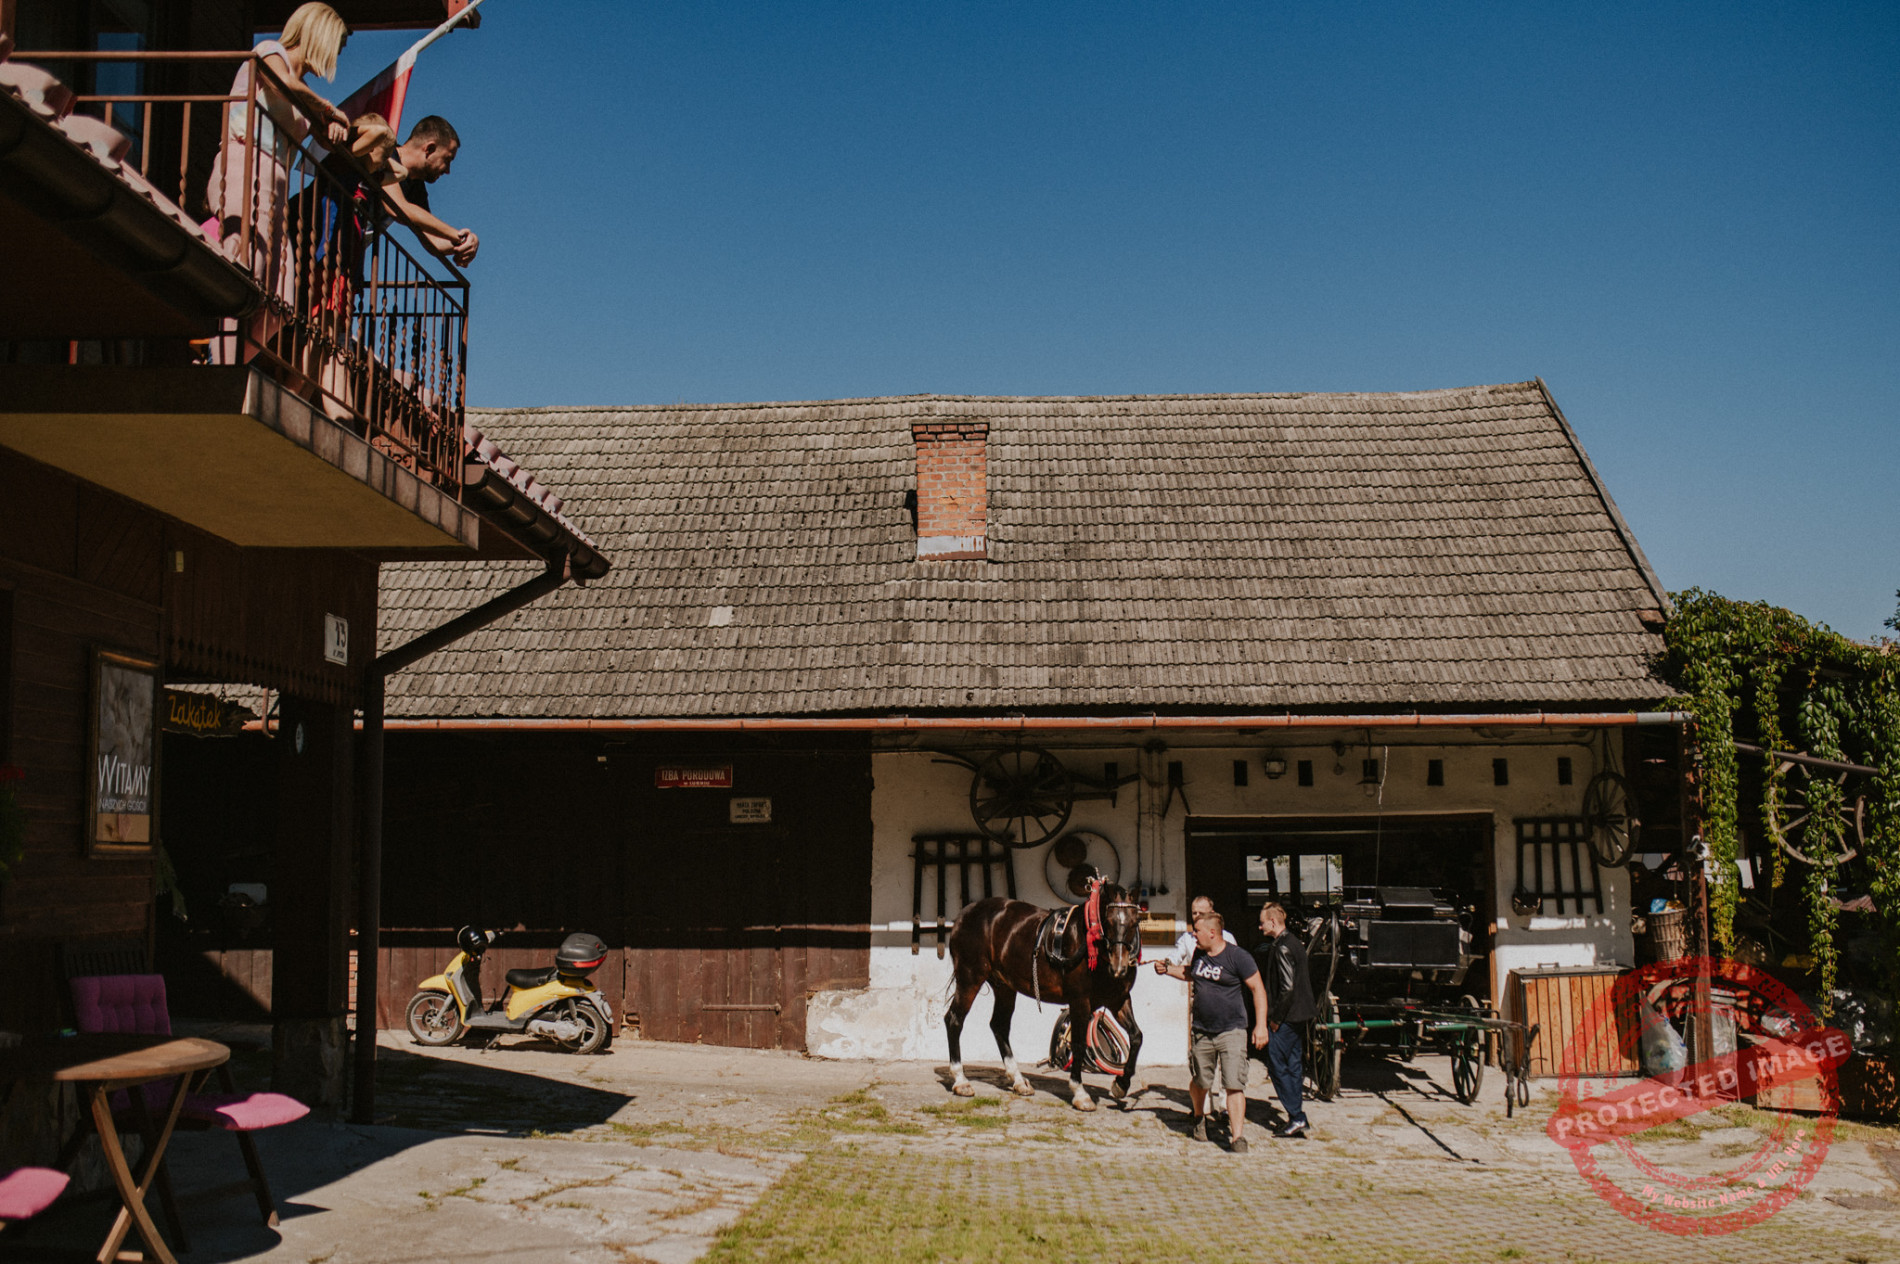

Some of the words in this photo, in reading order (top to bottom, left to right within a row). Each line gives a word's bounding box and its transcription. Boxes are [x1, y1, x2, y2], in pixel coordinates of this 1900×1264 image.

[335, 621, 346, 648] 13
[168, 694, 221, 732] Zakątek
[661, 770, 679, 781] IZBA
[1196, 959, 1221, 980] Lee
